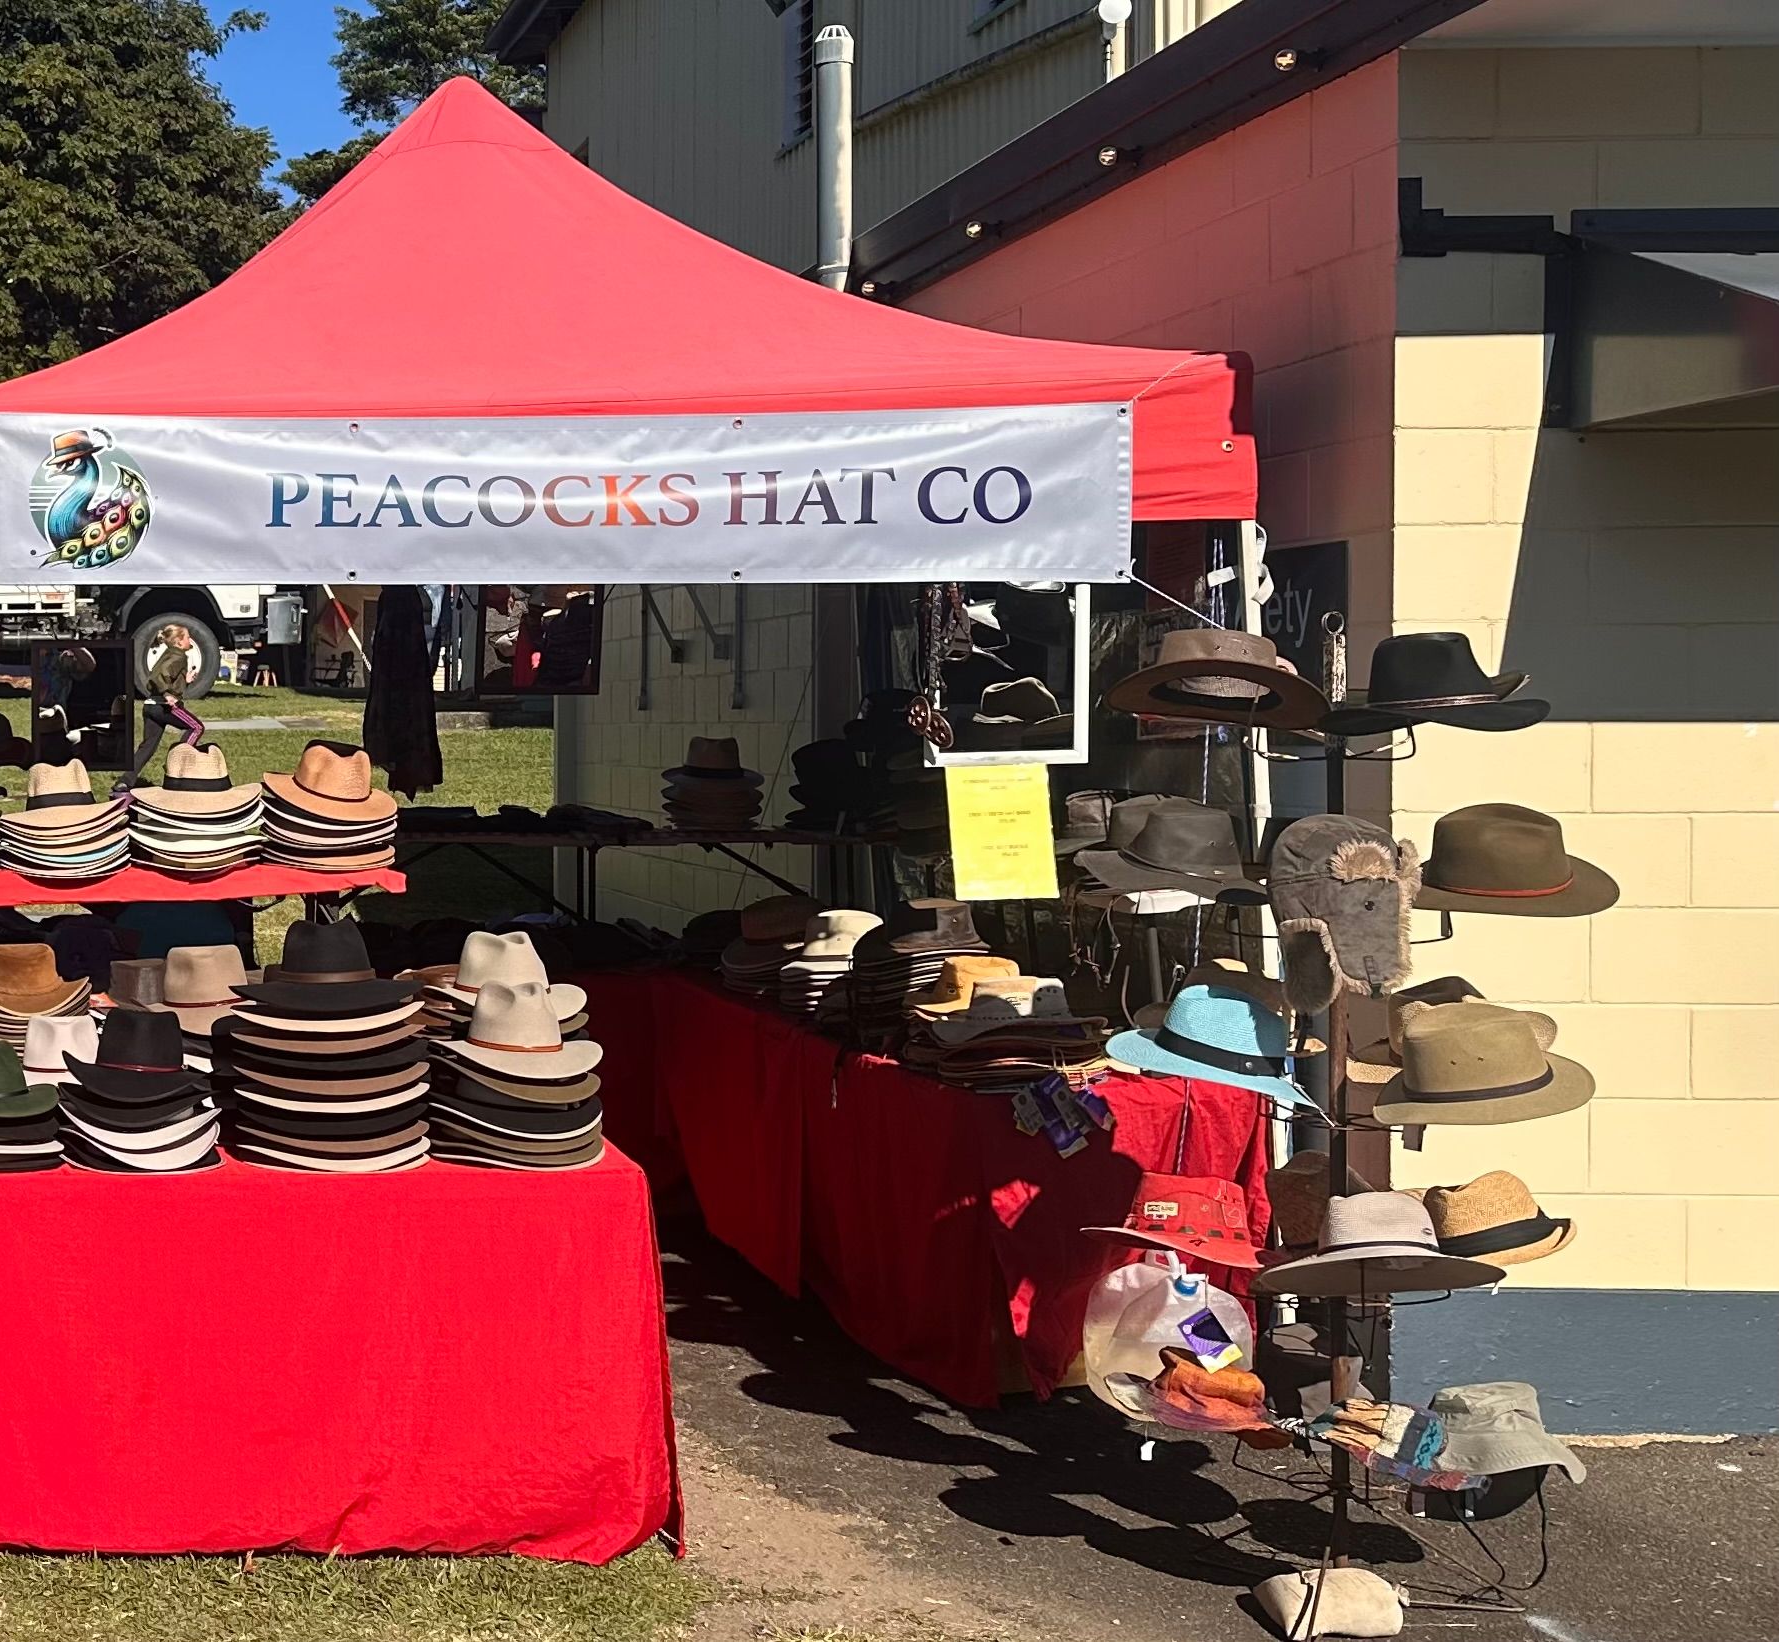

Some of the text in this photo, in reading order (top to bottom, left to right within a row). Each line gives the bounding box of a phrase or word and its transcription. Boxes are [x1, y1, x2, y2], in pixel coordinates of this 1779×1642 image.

[265, 465, 1033, 529] PEACOCKS HAT CO
